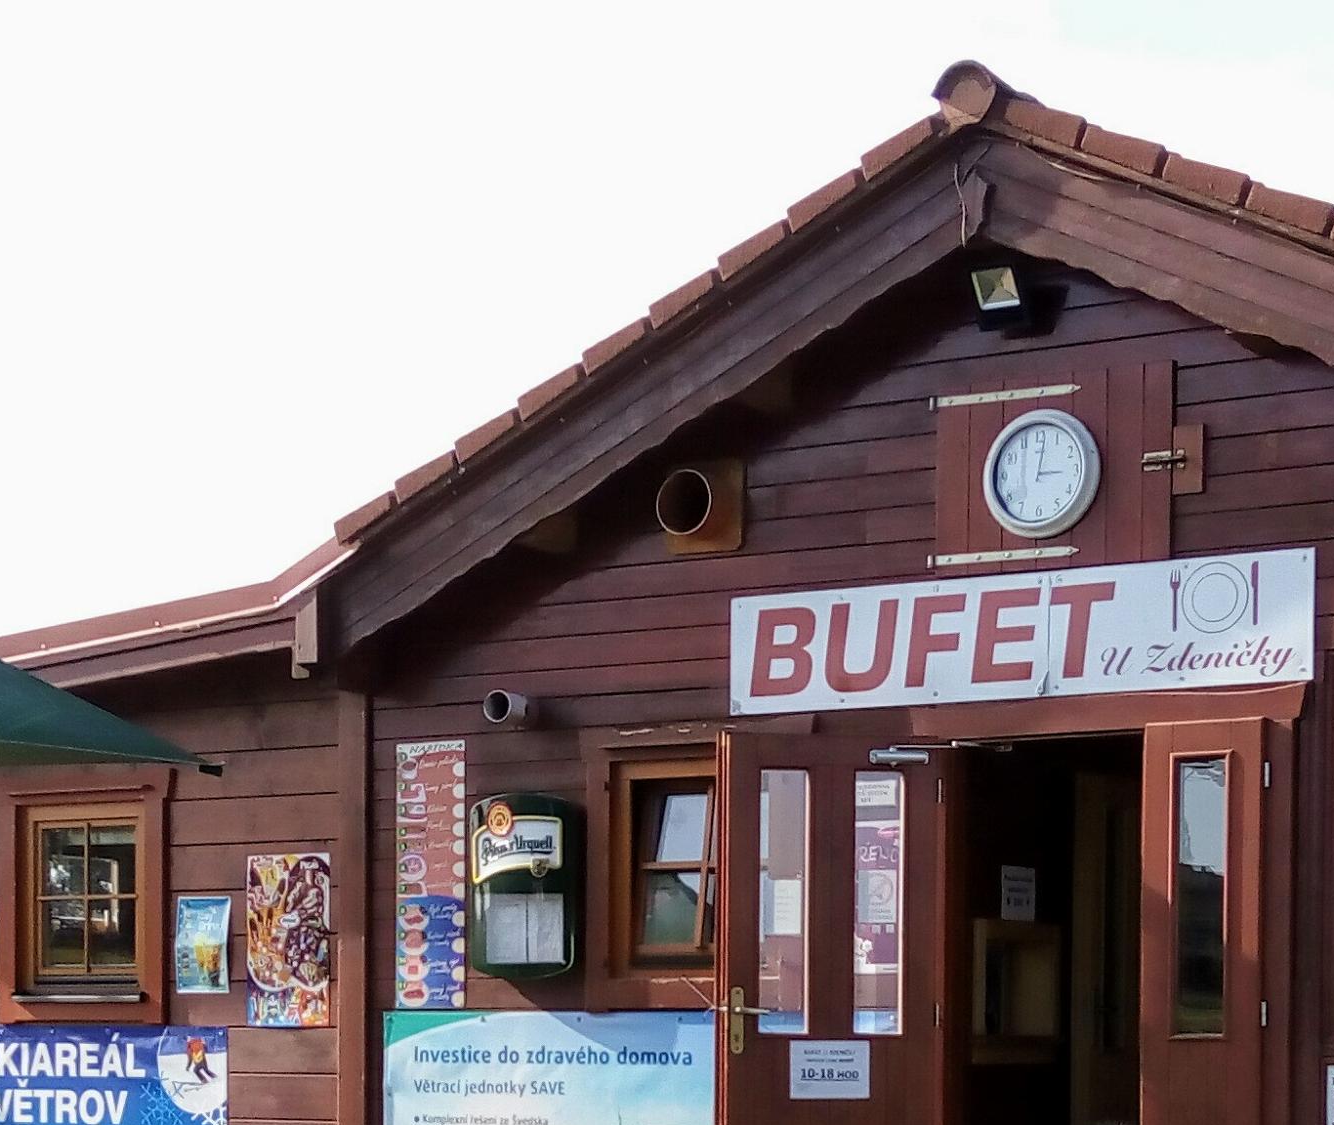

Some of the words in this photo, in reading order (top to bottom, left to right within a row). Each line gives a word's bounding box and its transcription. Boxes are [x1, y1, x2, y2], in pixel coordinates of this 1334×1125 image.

[1035, 430, 1045, 443] 12
[1055, 432, 1060, 446] 1
[1067, 445, 1074, 458] 2
[1073, 463, 1080, 477] 3
[1017, 501, 1024, 515] 7
[1035, 504, 1043, 517] 6
[1053, 498, 1060, 511] 5
[749, 580, 1117, 698] BUFET
[1101, 646, 1134, 677] U
[1140, 636, 1297, 678] Zdeničky
[414, 1045, 492, 1064] Investice
[498, 1045, 519, 1064] do
[526, 1045, 610, 1065] zdravého
[617, 1047, 693, 1066] domova
[801, 1068, 834, 1079] 10-18
[414, 1079, 461, 1094] Větrací
[464, 1079, 526, 1098] jednotky
[530, 1080, 566, 1096] SAVE
[422, 1114, 468, 1125] Komplexní
